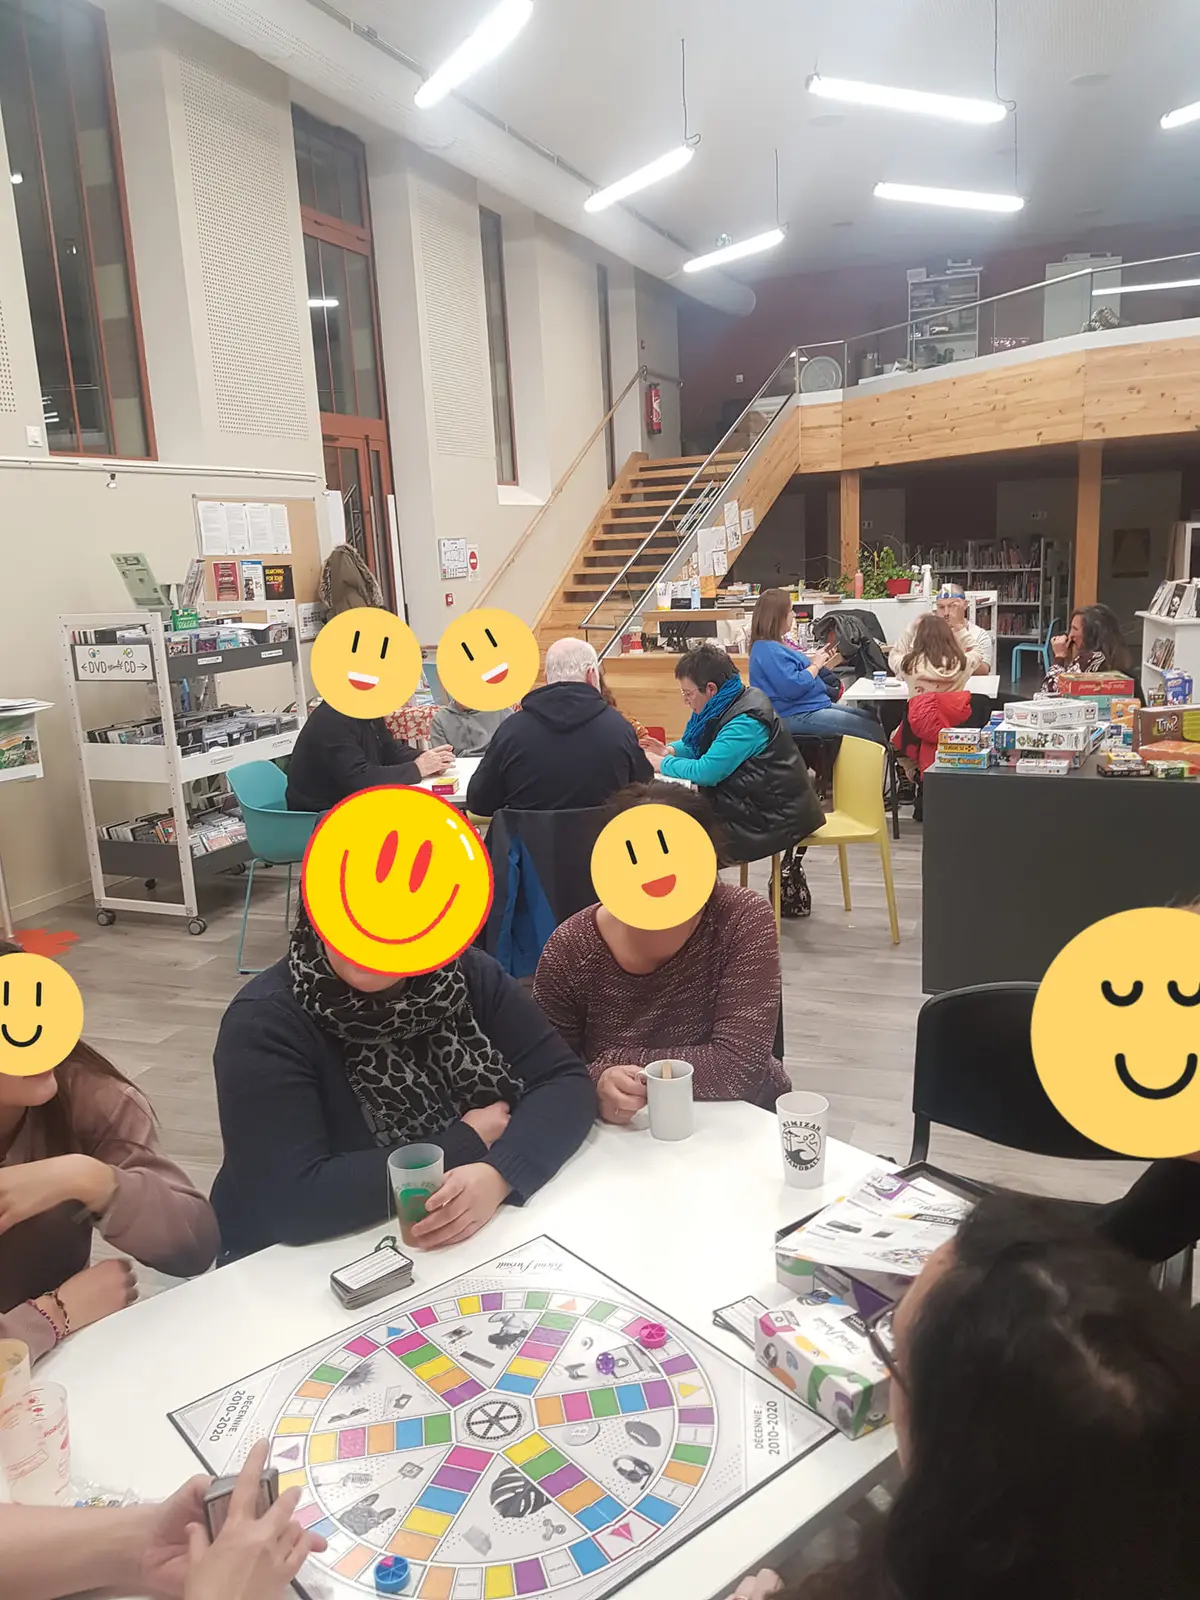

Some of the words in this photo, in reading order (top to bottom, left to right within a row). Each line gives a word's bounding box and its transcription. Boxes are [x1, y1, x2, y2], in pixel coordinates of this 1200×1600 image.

[88, 661, 107, 673] DVD
[124, 661, 136, 673] CD
[209, 1390, 245, 1441] 2010-2020
[766, 1400, 780, 1455] 2010-2020
